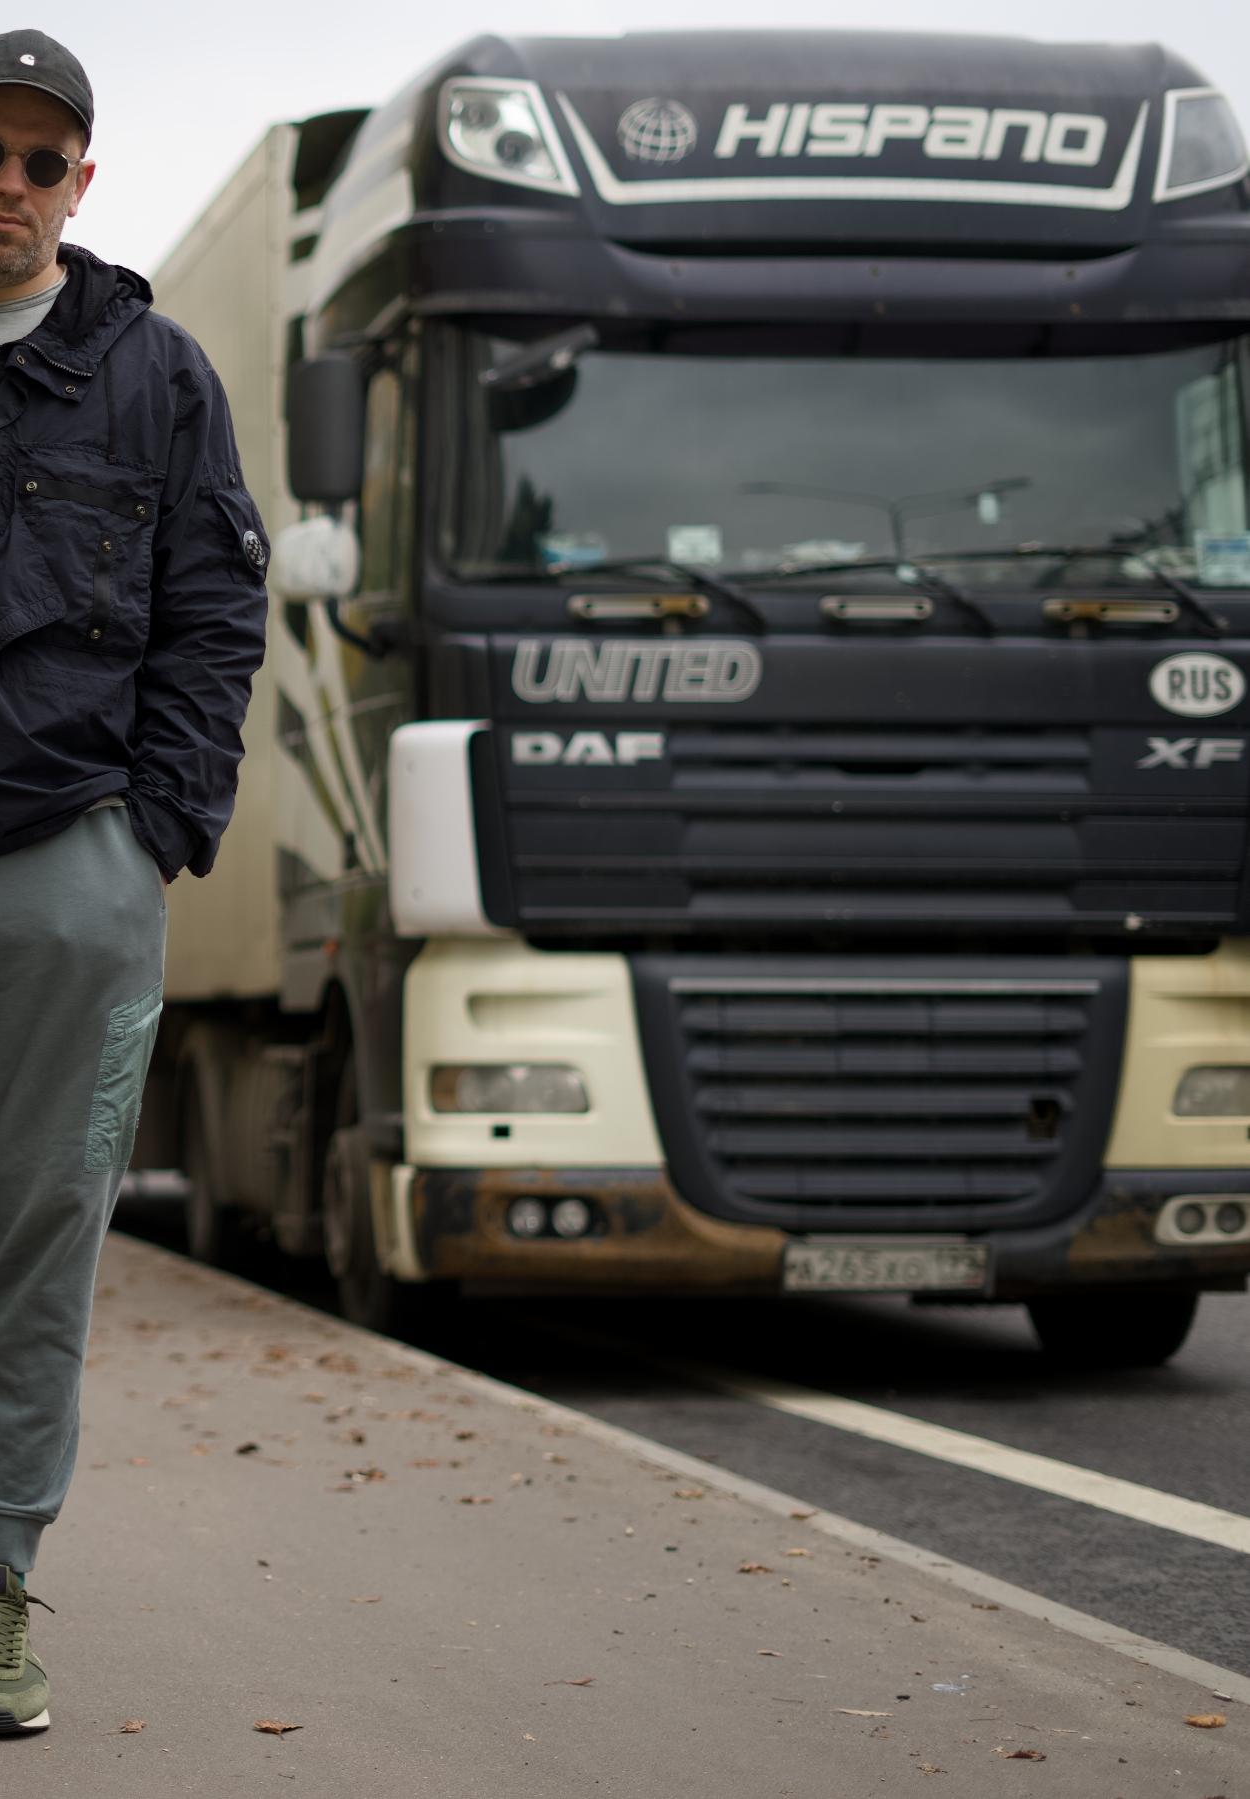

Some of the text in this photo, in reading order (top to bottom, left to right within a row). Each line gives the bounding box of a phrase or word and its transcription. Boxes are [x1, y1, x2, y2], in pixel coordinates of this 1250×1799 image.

[511, 639, 762, 703] UNITED
[1168, 668, 1232, 700] RUS
[511, 732, 664, 765] DAF
[1136, 737, 1245, 769] XF
